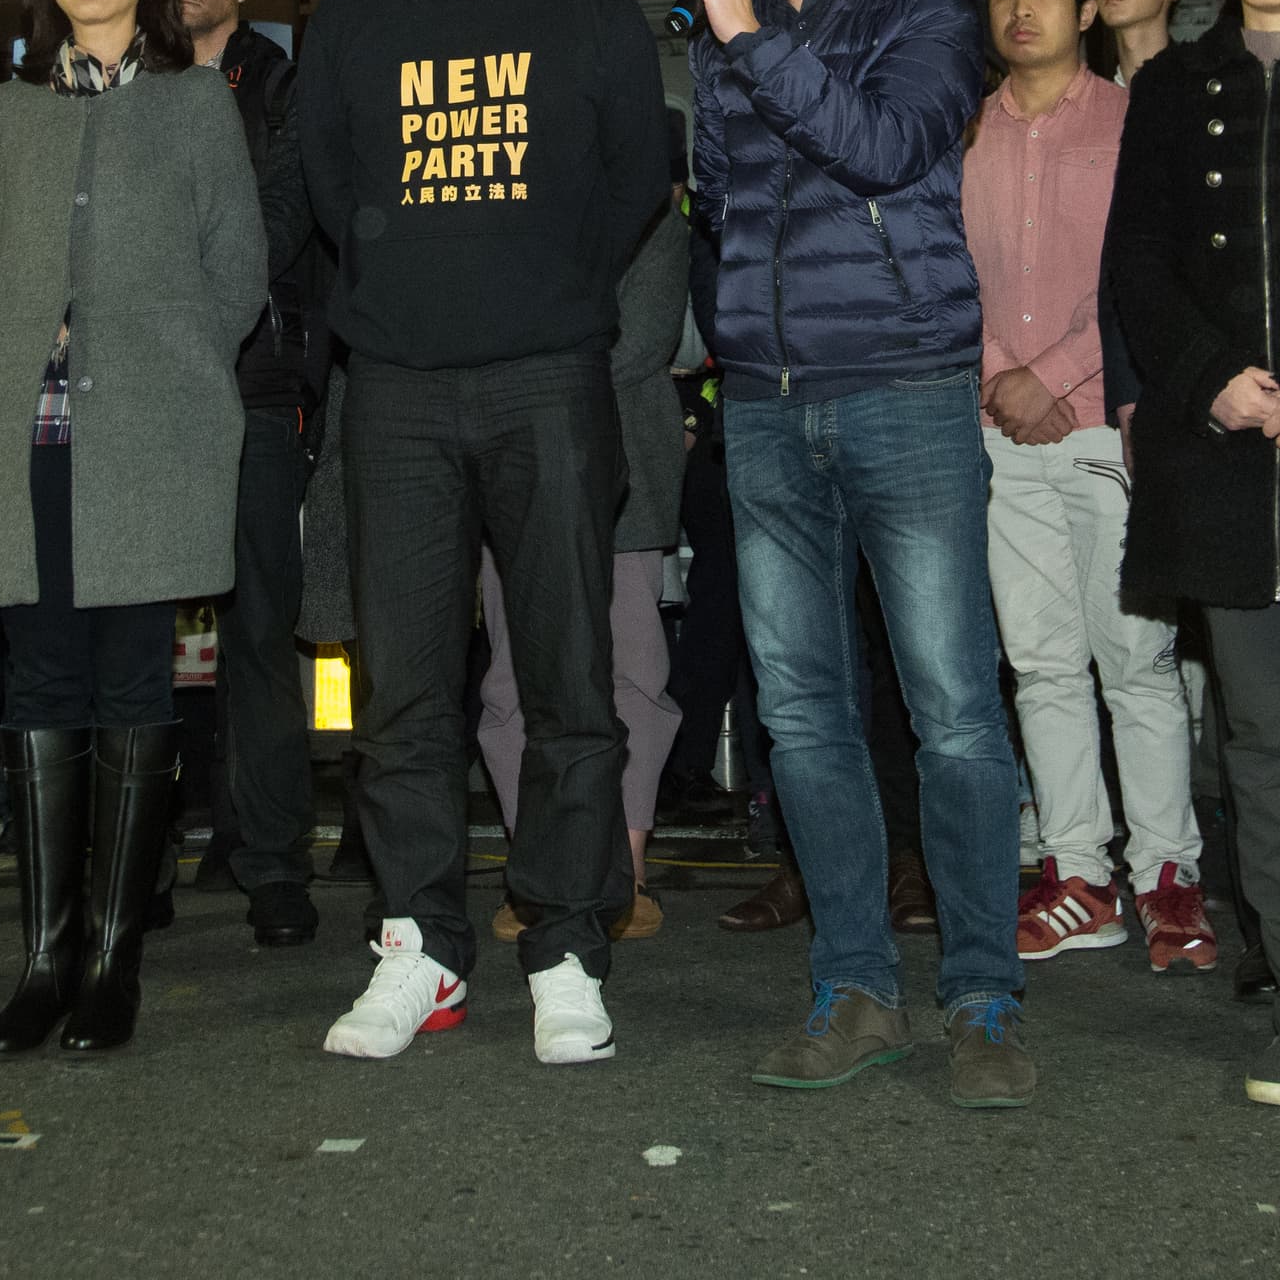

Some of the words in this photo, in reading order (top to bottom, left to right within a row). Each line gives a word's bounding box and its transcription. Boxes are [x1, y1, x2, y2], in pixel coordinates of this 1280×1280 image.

[401, 52, 532, 107] NEW
[401, 103, 528, 144] POWER
[401, 141, 529, 183] PARTY
[400, 183, 528, 206] 人民的立法院
